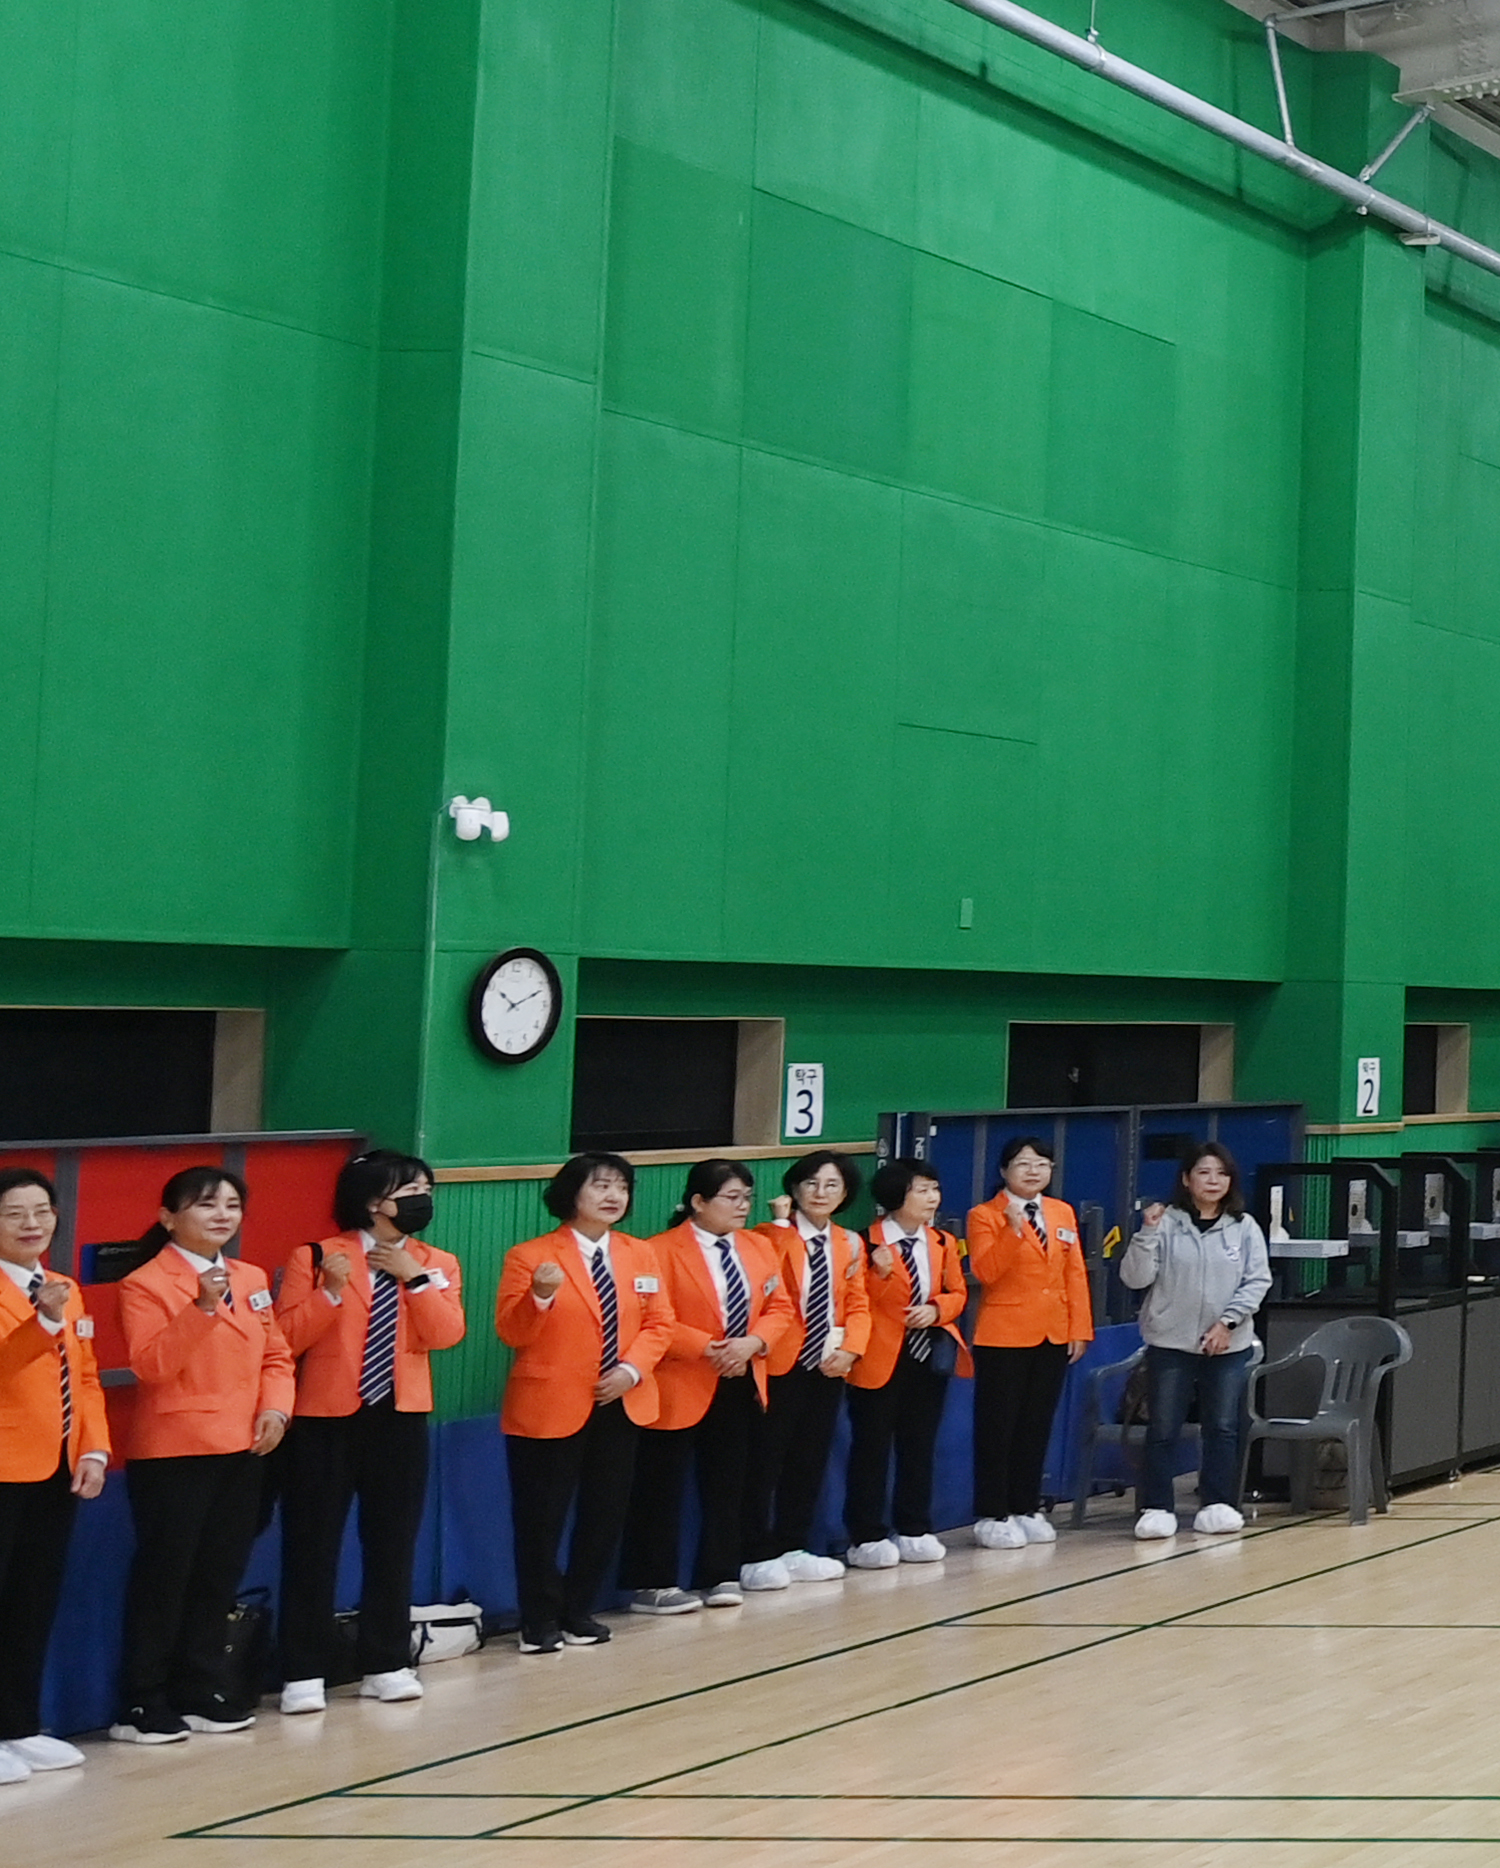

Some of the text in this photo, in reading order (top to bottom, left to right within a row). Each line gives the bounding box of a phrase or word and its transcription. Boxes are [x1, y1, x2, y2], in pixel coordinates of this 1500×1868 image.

[795, 1068, 818, 1086] 탁구
[794, 1089, 814, 1135] 3
[1362, 1078, 1374, 1114] 2
